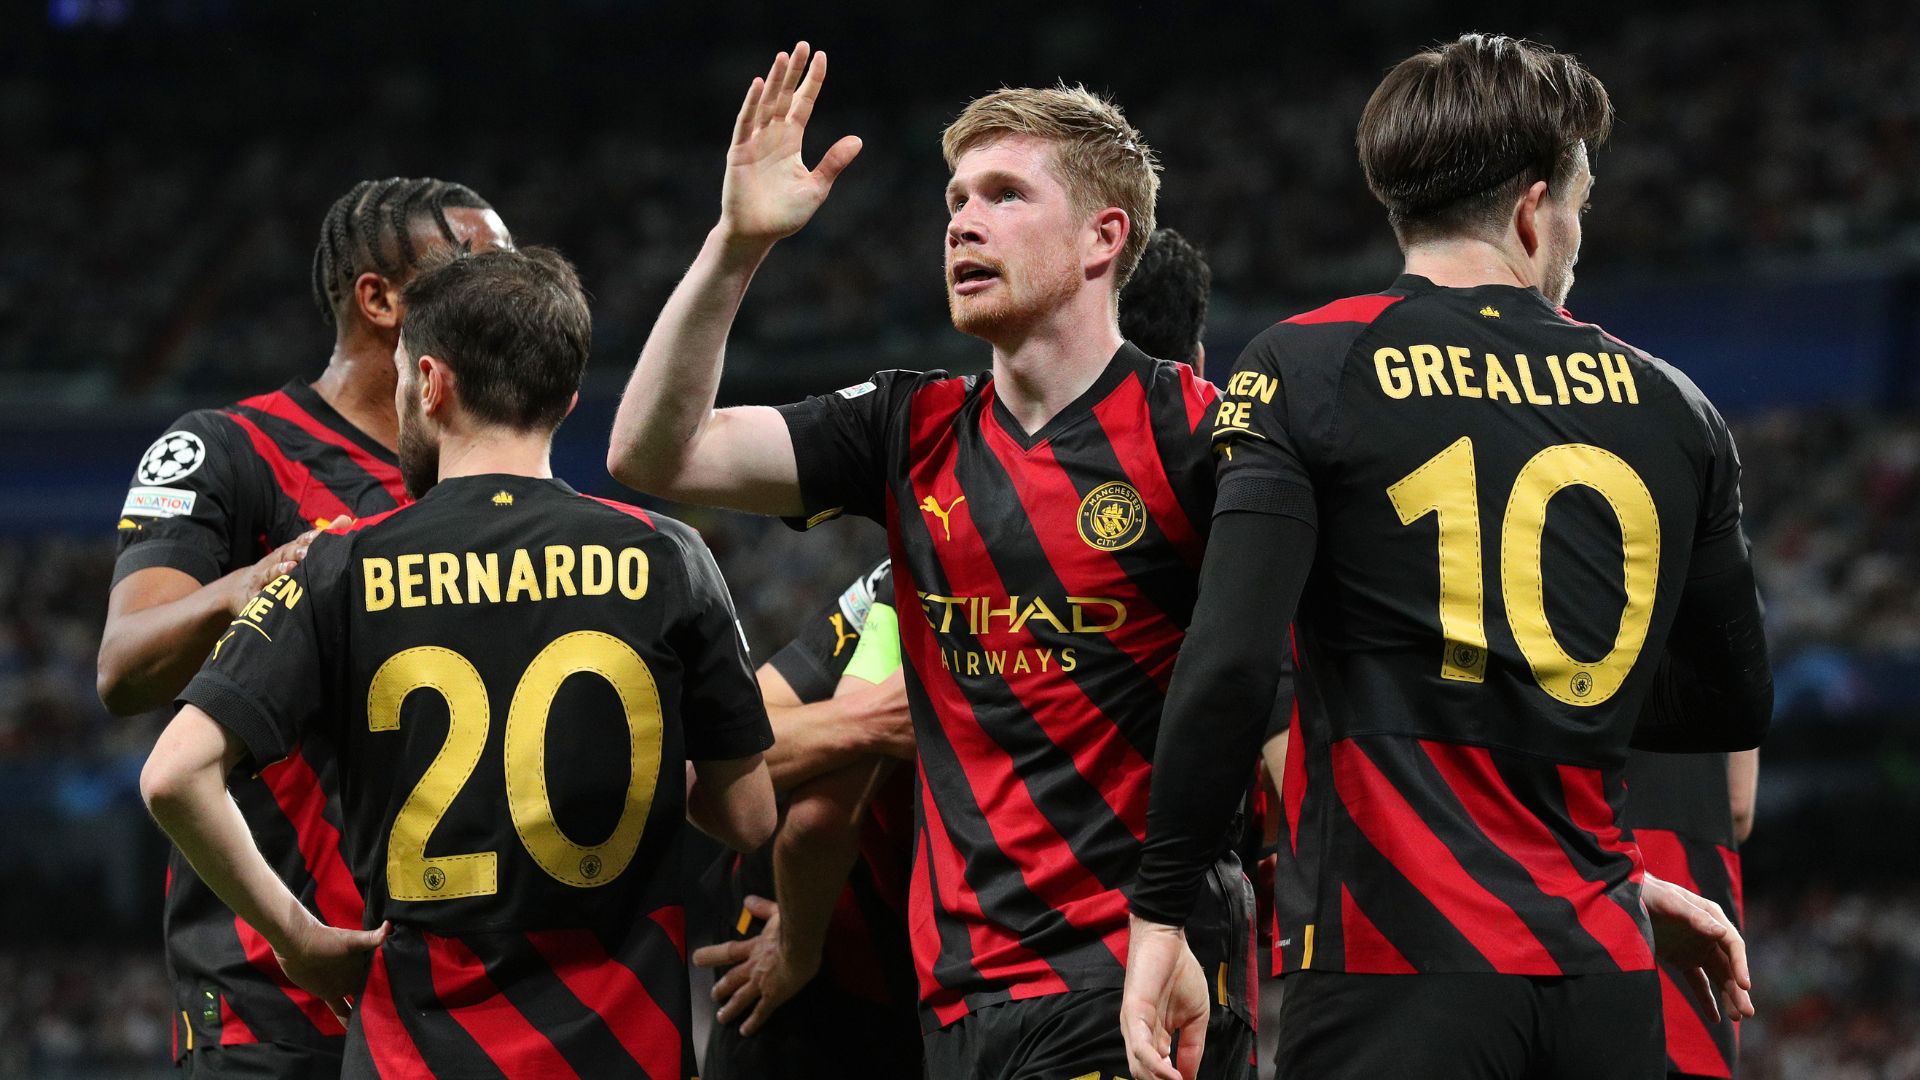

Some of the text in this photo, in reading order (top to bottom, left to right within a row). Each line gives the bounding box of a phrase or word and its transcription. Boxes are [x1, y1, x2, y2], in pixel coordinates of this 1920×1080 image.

[1373, 344, 1639, 405] GREALISH
[1088, 487, 1140, 512] MANCHESTER
[1096, 538, 1117, 546] CITY
[1386, 435, 1661, 707] 10
[363, 545, 649, 612] BERNARDO
[941, 647, 1077, 676] AIRWAYS
[367, 630, 664, 901] 20
